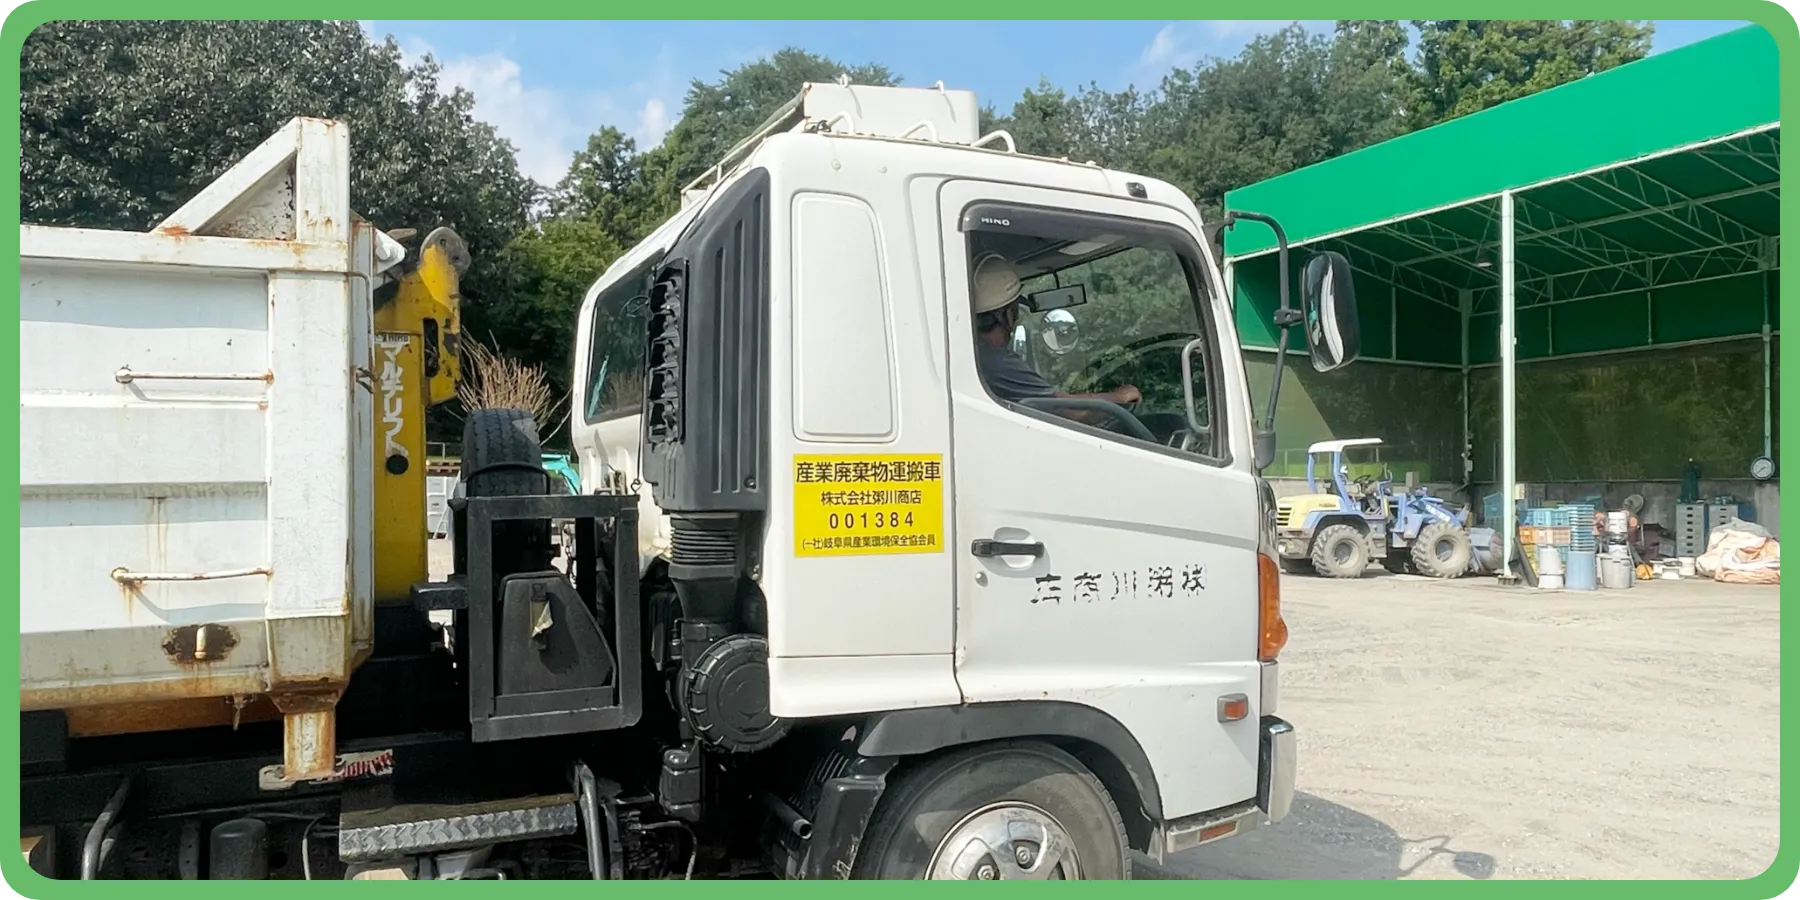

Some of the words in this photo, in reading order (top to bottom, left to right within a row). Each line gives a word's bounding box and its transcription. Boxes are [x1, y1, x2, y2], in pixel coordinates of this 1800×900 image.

[981, 217, 1010, 226] HINO
[796, 461, 941, 483] 産業廃棄物運搬車
[820, 490, 922, 506] 株式会社粥川商店
[829, 511, 914, 529] 001384
